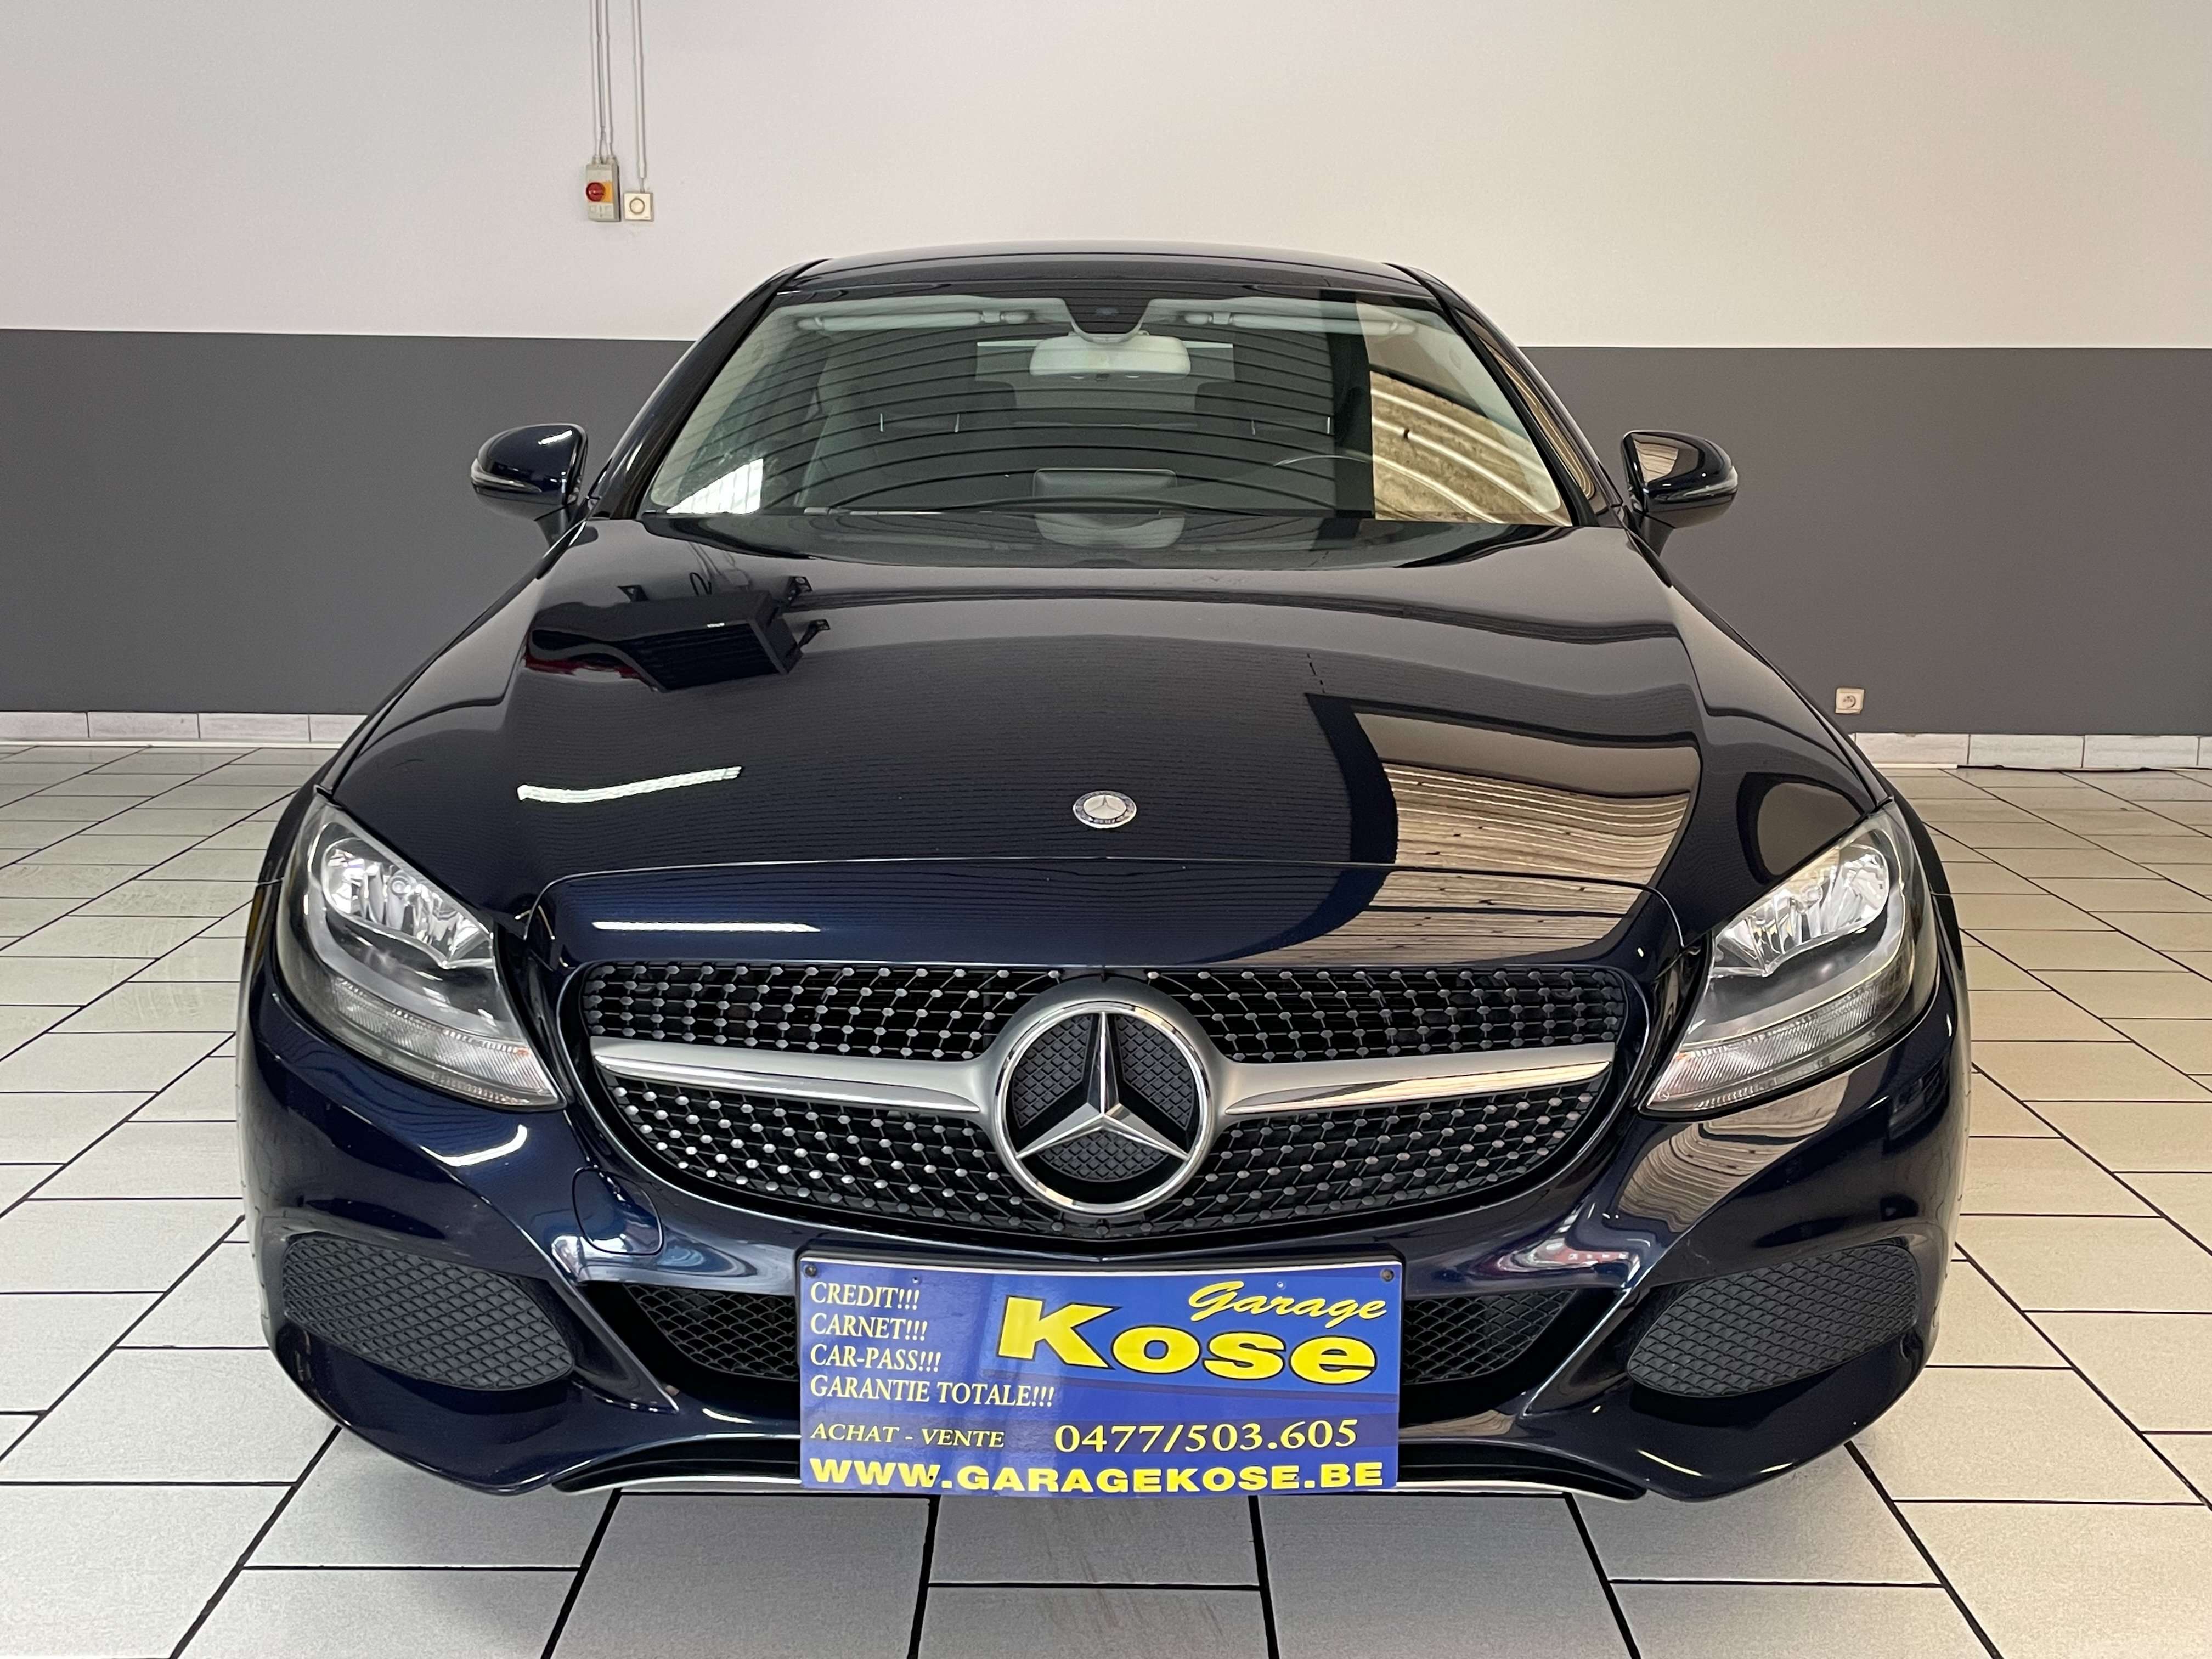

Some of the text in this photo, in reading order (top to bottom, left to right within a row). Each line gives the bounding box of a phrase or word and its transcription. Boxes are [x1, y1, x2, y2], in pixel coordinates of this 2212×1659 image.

[810, 1281, 920, 1311] CREDIT!!!
[1188, 1280, 1387, 1329] Garage
[810, 1313, 928, 1341] CARNET!!!
[997, 1296, 1376, 1385] Kose
[810, 1343, 941, 1373] CAR-PASS!!!
[810, 1374, 1055, 1407] GARANTIE TOTALE!!!
[810, 1422, 900, 1443] ACHAT
[921, 1428, 1005, 1448] VENTE
[1054, 1419, 1358, 1453] 0477/503.605
[809, 1457, 1383, 1493] WWW.GARAGEKOSE.BE
